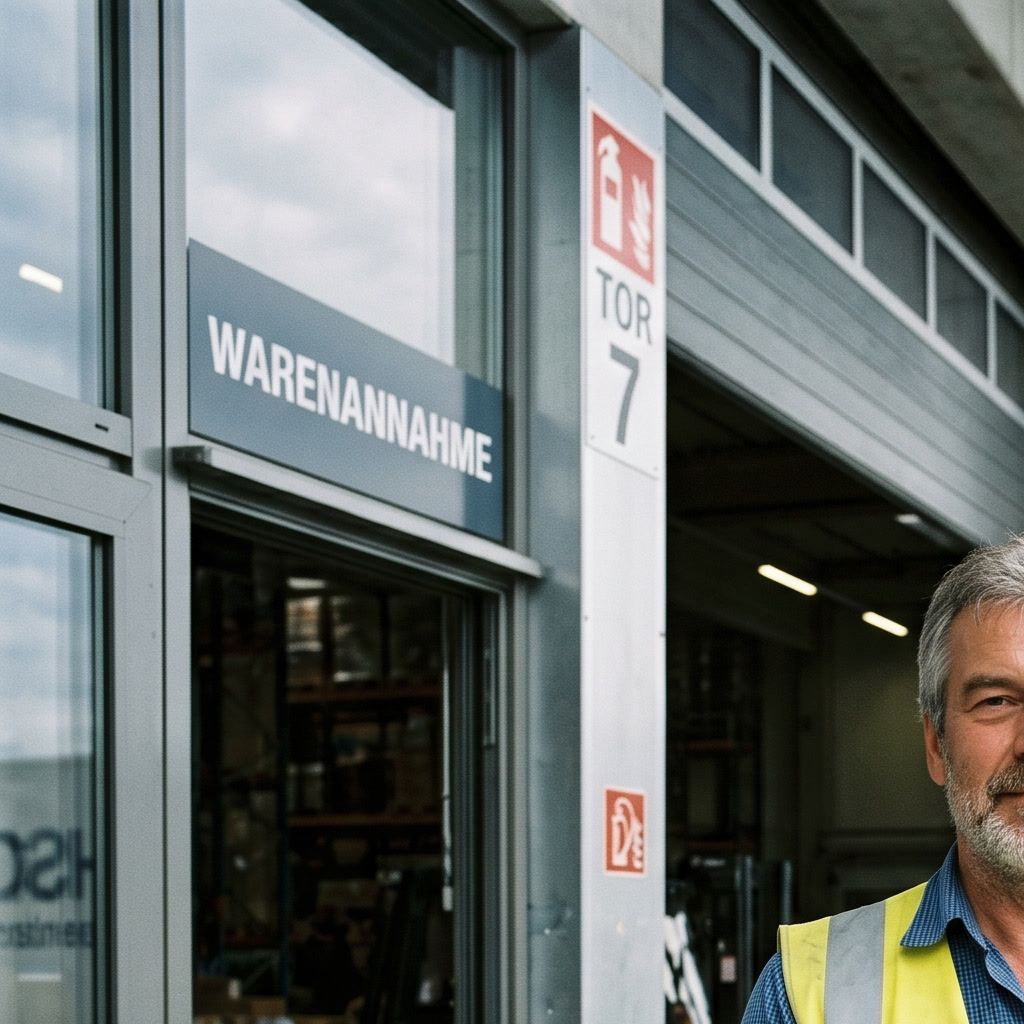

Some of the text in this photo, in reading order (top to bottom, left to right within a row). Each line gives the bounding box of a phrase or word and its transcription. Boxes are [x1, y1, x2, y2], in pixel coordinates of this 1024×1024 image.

[597, 266, 652, 345] TOR
[207, 314, 493, 484] WARENANNAHME
[610, 343, 640, 446] 7
